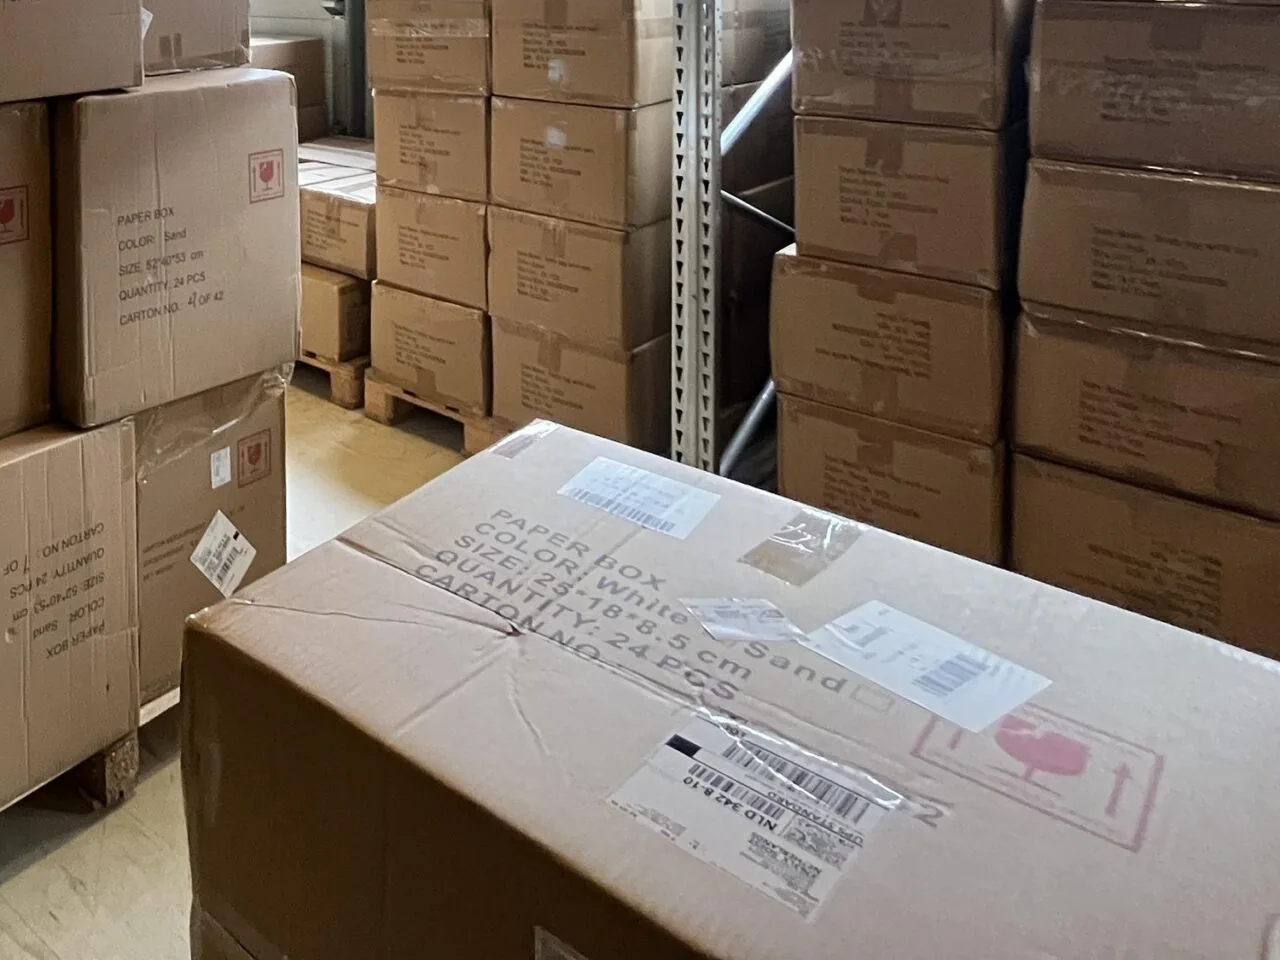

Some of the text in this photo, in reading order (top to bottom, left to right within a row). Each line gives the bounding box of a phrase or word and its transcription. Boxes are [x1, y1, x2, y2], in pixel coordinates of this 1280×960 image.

[117, 207, 175, 226] PAPER BOX
[164, 228, 187, 242] Sand
[190, 250, 204, 261] cm
[173, 277, 184, 289] 24
[187, 271, 206, 285] PCS
[120, 306, 161, 326] CARTON
[199, 292, 212, 305] OF
[214, 290, 224, 301] 42
[61, 521, 105, 551] CARTON
[491, 509, 670, 593] PAPER BOX
[3, 559, 19, 577] OF
[9, 580, 33, 599] PCS
[35, 572, 48, 588] 24
[414, 563, 546, 633] CARTON
[455, 534, 530, 576] SIZE:
[697, 649, 753, 681] cm
[475, 522, 849, 694] COLOR: White Sand
[12, 607, 29, 622] cm
[435, 549, 740, 701] QUANTITY: 24 PCS
[33, 619, 59, 640] Sand
[46, 619, 105, 660] PAPER BOX
[715, 793, 744, 813] 342
[744, 809, 778, 831] NLD
